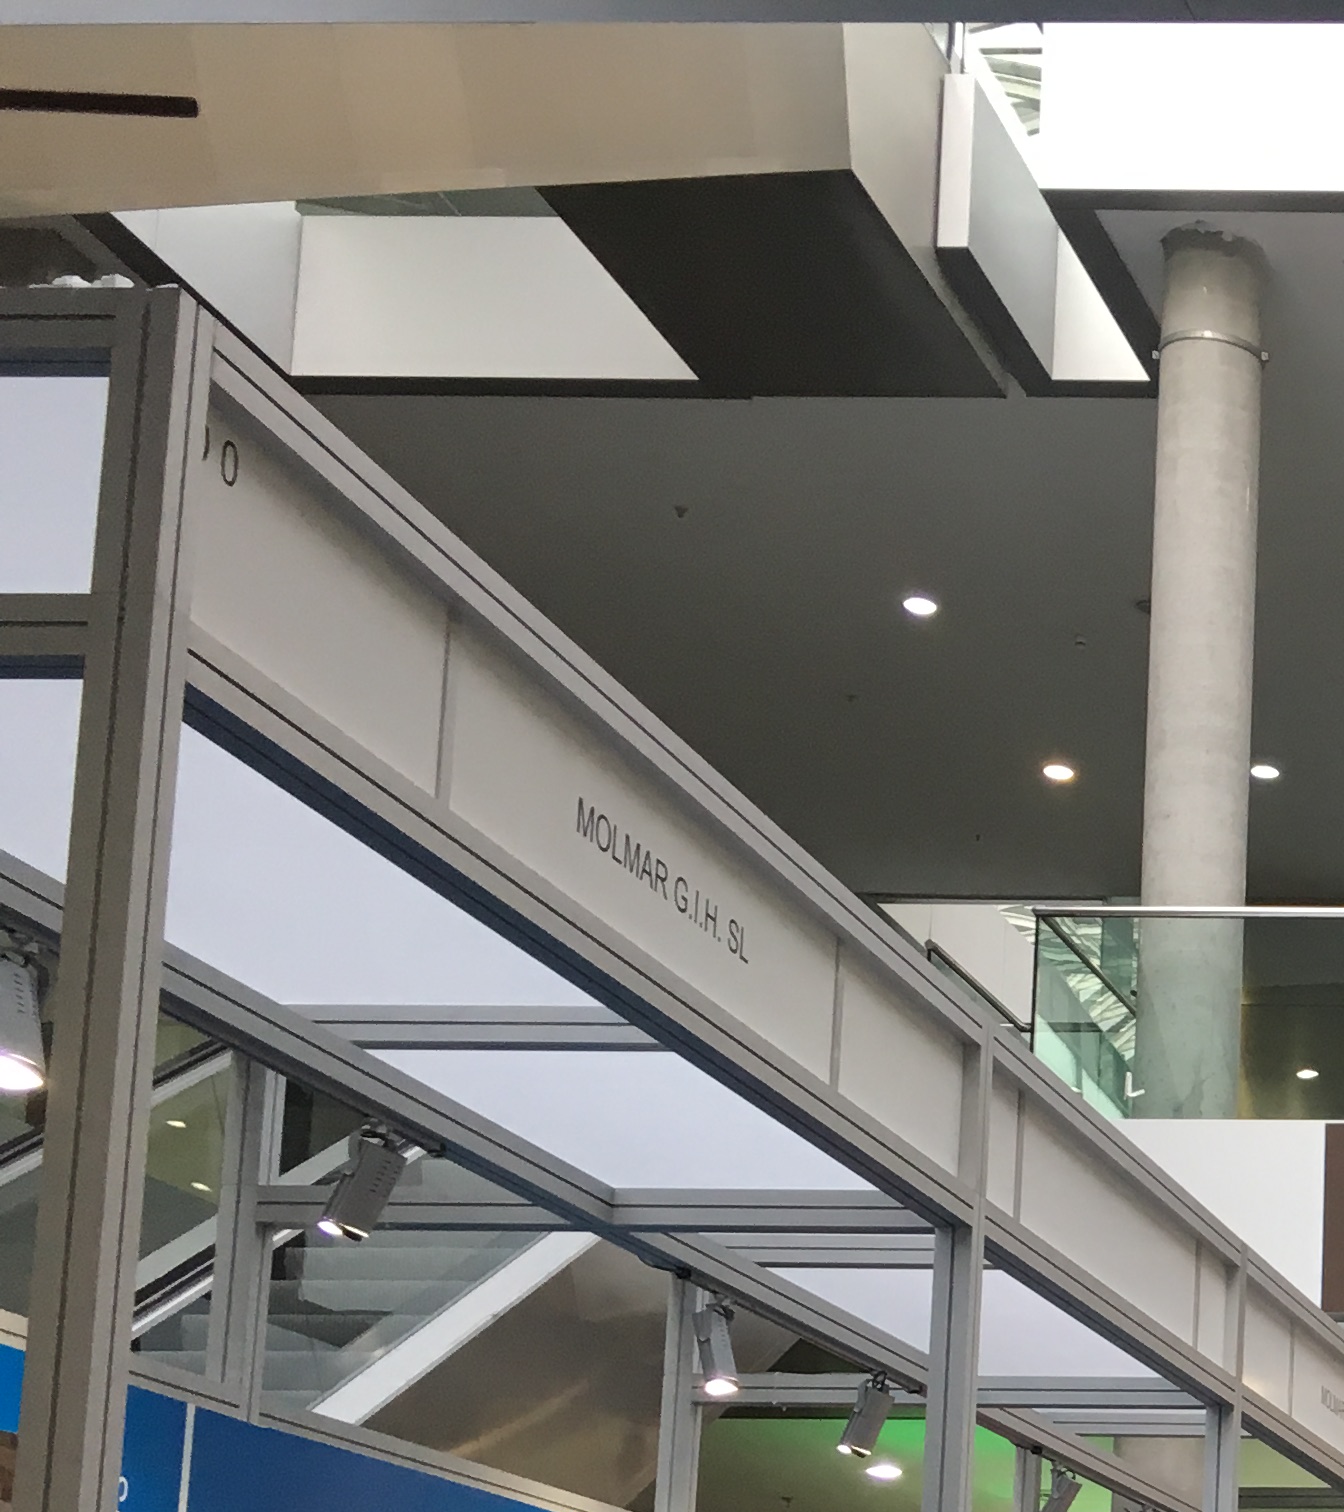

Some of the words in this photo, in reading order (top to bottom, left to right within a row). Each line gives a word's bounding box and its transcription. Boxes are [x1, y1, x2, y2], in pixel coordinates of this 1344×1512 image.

[576, 796, 668, 900] MOLMAR
[674, 877, 721, 942] G.I.H.
[727, 919, 749, 964] SL
